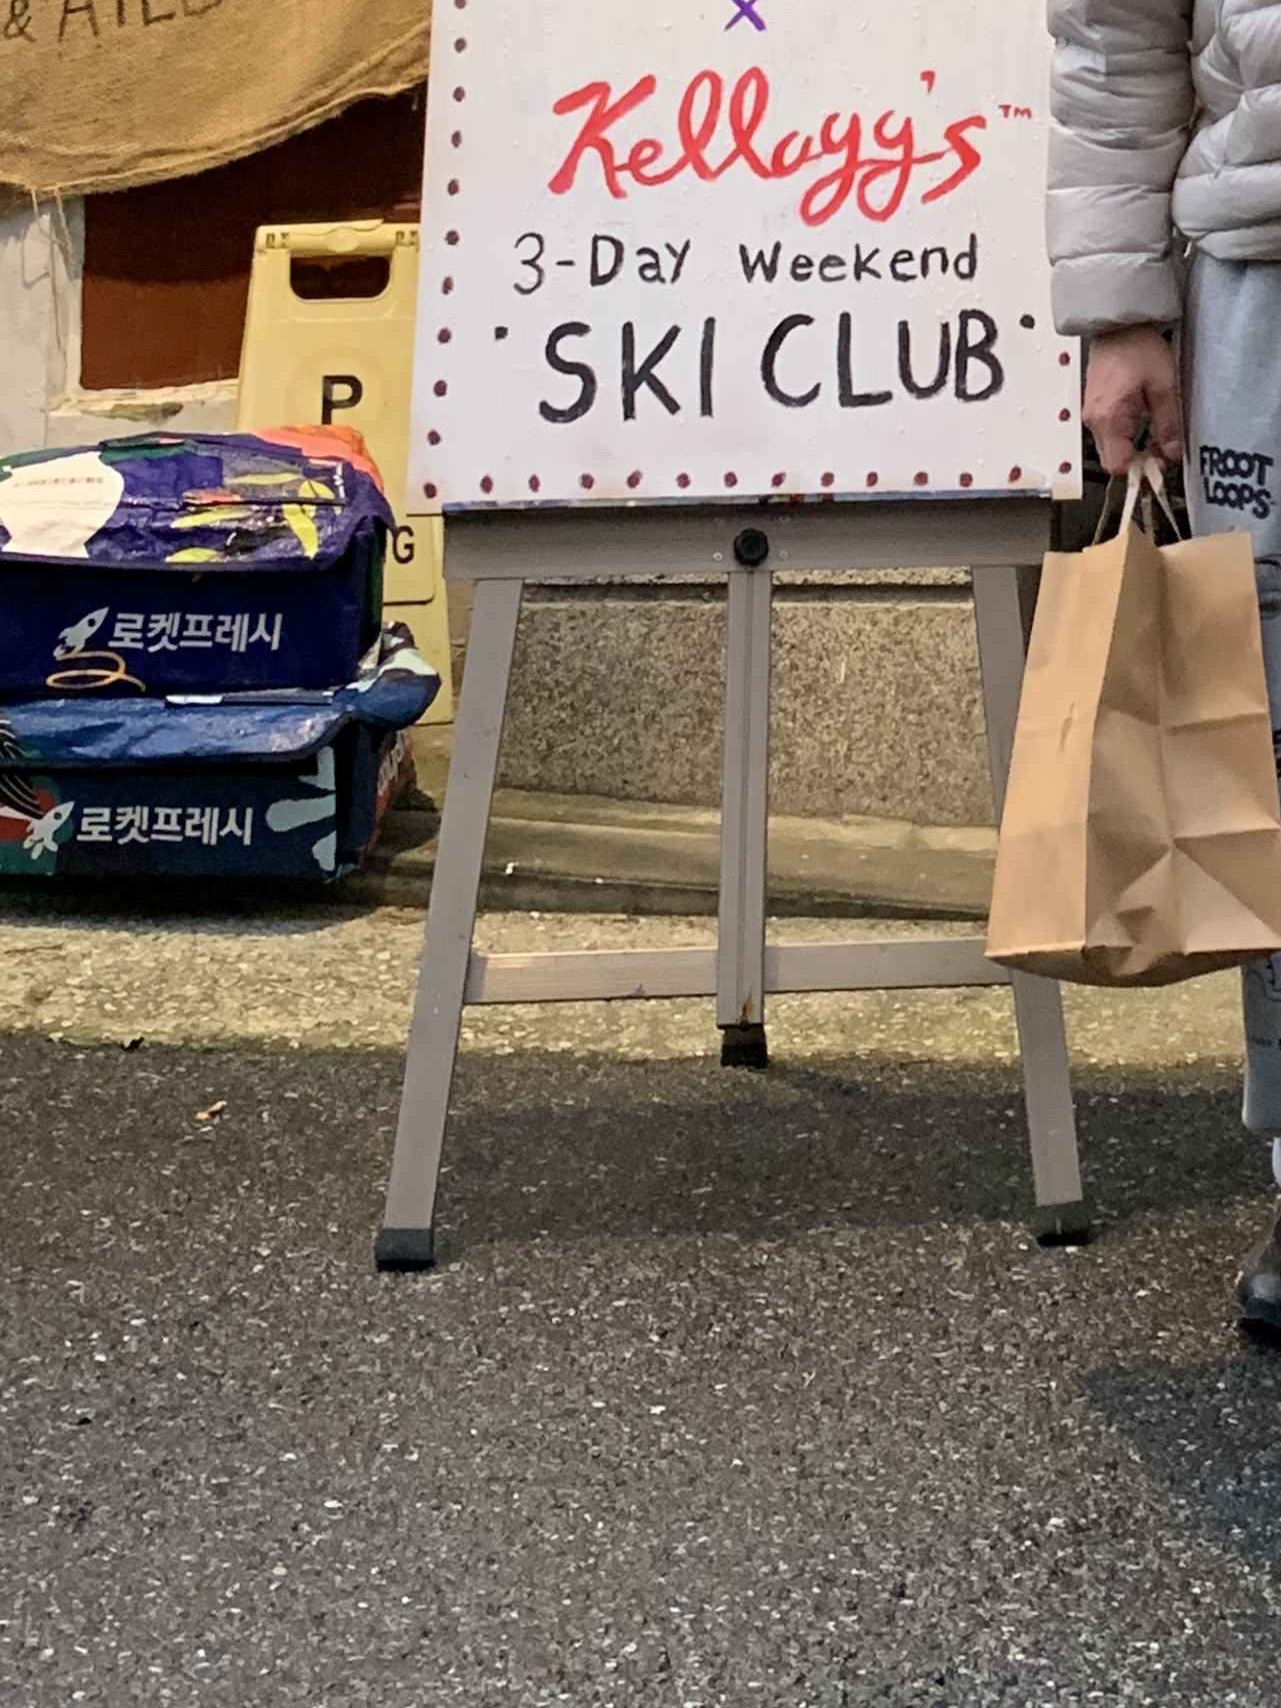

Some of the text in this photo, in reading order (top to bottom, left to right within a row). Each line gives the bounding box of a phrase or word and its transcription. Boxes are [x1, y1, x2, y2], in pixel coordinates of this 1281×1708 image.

[548, 66, 987, 227] Kellogg's
[513, 232, 691, 295] 3-Day
[539, 308, 1005, 424] SKI CLUB
[321, 375, 363, 425] P
[1199, 445, 1274, 486] FROOT
[1203, 477, 1271, 520] LOOPS
[107, 612, 283, 654] 로켓프레시
[76, 805, 254, 846] 로켓프레시
